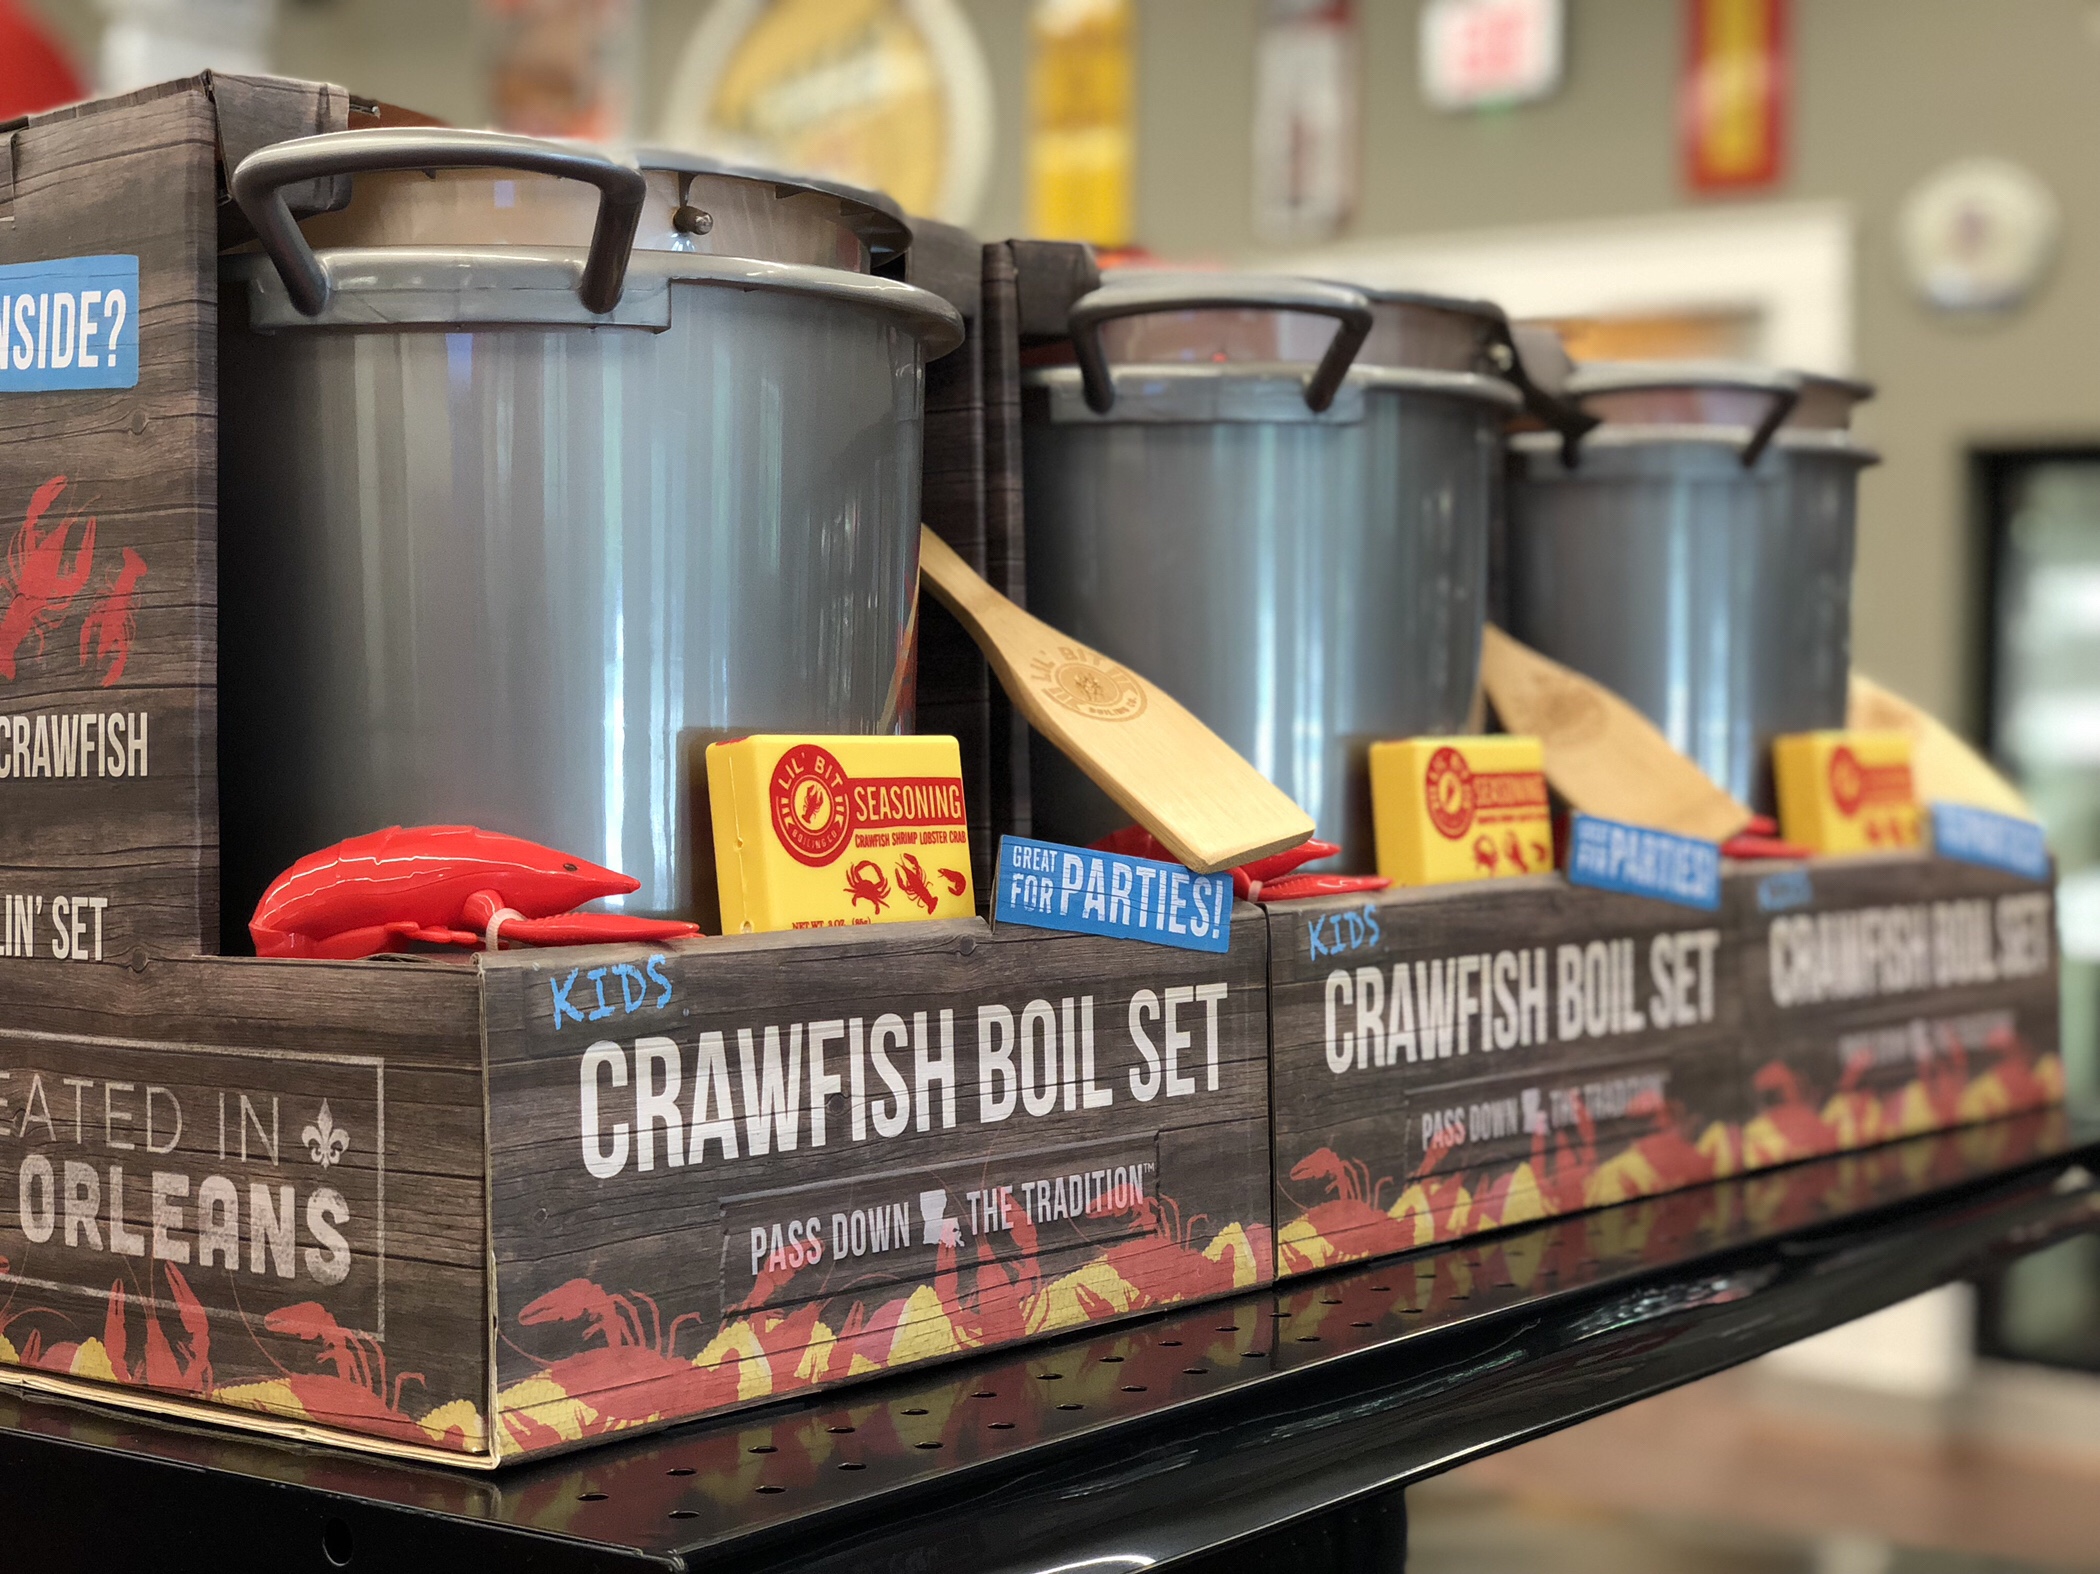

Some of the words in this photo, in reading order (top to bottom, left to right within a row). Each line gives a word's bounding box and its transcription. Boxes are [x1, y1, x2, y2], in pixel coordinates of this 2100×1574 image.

[0, 712, 148, 778] CRAWFISH
[814, 755, 844, 788] BIT
[853, 785, 962, 822] SEASONING
[855, 833, 890, 849] CRAWFISH
[892, 831, 918, 847] SHRIMP
[920, 830, 948, 845] LOBSTER
[949, 830, 967, 844] CRAB
[1012, 845, 1058, 873] GREAT
[52, 895, 108, 961] SET
[1010, 872, 1054, 913] FOR
[1060, 852, 1223, 940] PARTIES!
[1308, 904, 1380, 961] KIDS
[550, 954, 673, 1031] KIDS
[1325, 948, 1548, 1074] CRAWFISH
[1557, 938, 1646, 1041] BOIL
[1649, 929, 1720, 1030] SET
[580, 1007, 957, 1179] CRAWFISH
[978, 995, 1112, 1124] BOIL
[1128, 983, 1229, 1102] SET
[219, 1092, 279, 1166] IN
[1421, 1107, 1466, 1151] PASS
[1469, 1098, 1518, 1142] DOWN
[19, 1154, 352, 1286] ORLEANS
[751, 1217, 823, 1275] PASS
[832, 1202, 910, 1260] DOWN
[966, 1185, 1014, 1236] THE
